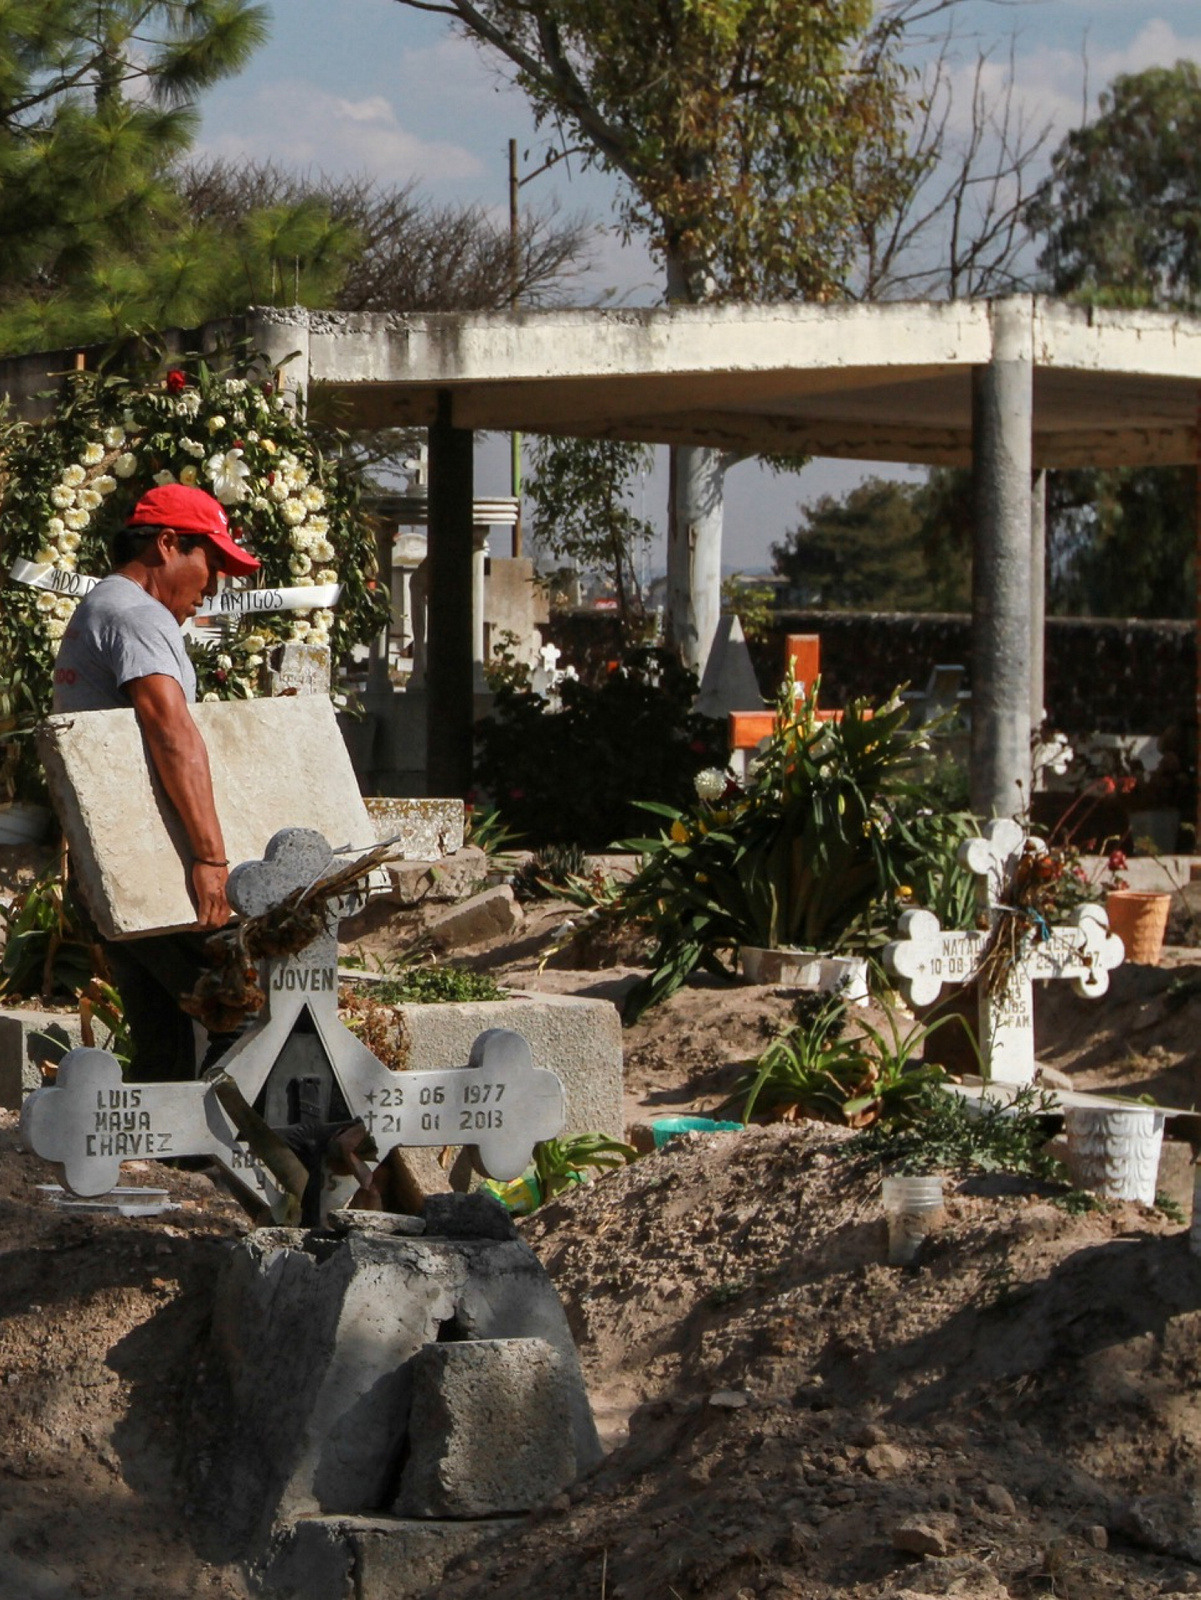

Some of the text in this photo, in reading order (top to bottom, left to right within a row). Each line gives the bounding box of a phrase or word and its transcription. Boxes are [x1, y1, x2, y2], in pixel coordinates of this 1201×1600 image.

[220, 588, 284, 613] AMIGOS
[272, 967, 335, 992] JOVEN
[96, 1089, 143, 1111] LUIS
[418, 1086, 445, 1106] 06
[462, 1083, 506, 1105] 1977
[94, 1110, 151, 1133] MAYA
[421, 1113, 440, 1131] 01
[459, 1110, 504, 1130] 2013
[85, 1132, 174, 1157] CHAVEZ
